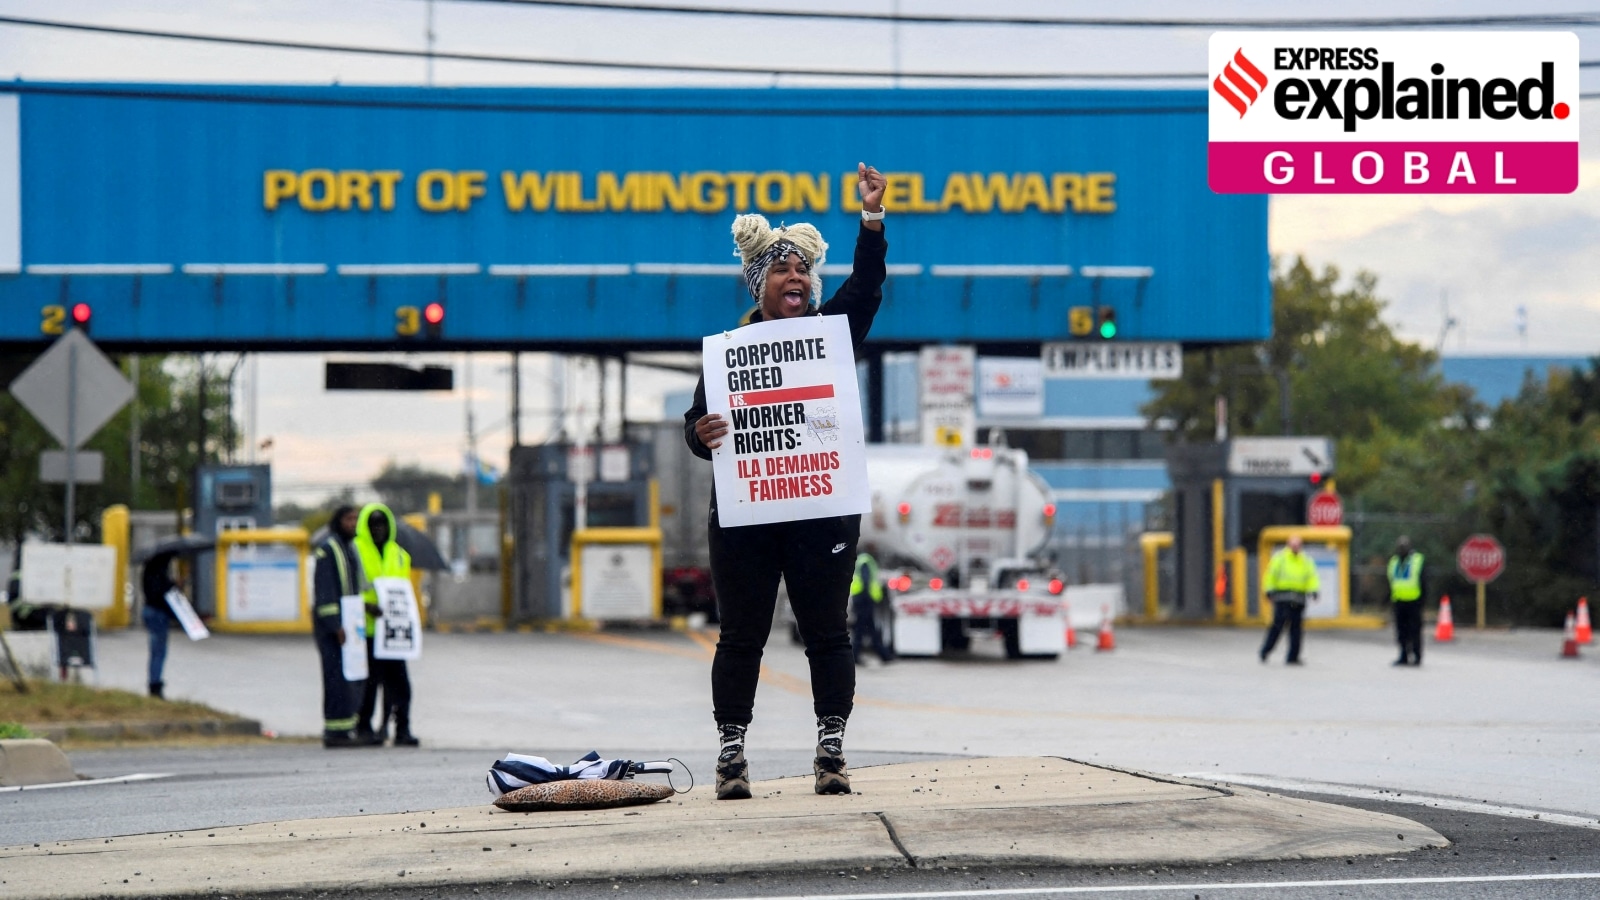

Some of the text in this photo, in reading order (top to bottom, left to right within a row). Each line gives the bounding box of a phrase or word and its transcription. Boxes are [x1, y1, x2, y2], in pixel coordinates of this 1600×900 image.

[263, 170, 401, 211] PORT
[416, 170, 486, 211] OF
[502, 172, 830, 212] WILMINGTON
[41, 305, 66, 335] 2
[395, 305, 420, 336] 3
[1068, 306, 1093, 336] 5
[725, 338, 826, 368] CORPORATE
[1046, 344, 1175, 371] EMPLOYEES
[727, 366, 783, 392] GREED
[731, 394, 748, 406] VS.
[731, 402, 806, 430] WORKER
[734, 428, 802, 455] RIGHTS:
[737, 451, 840, 479] ILA DEMANDS
[748, 473, 833, 502] FAIRNESS
[1309, 501, 1341, 521] STOP
[1461, 548, 1502, 567] STOP
